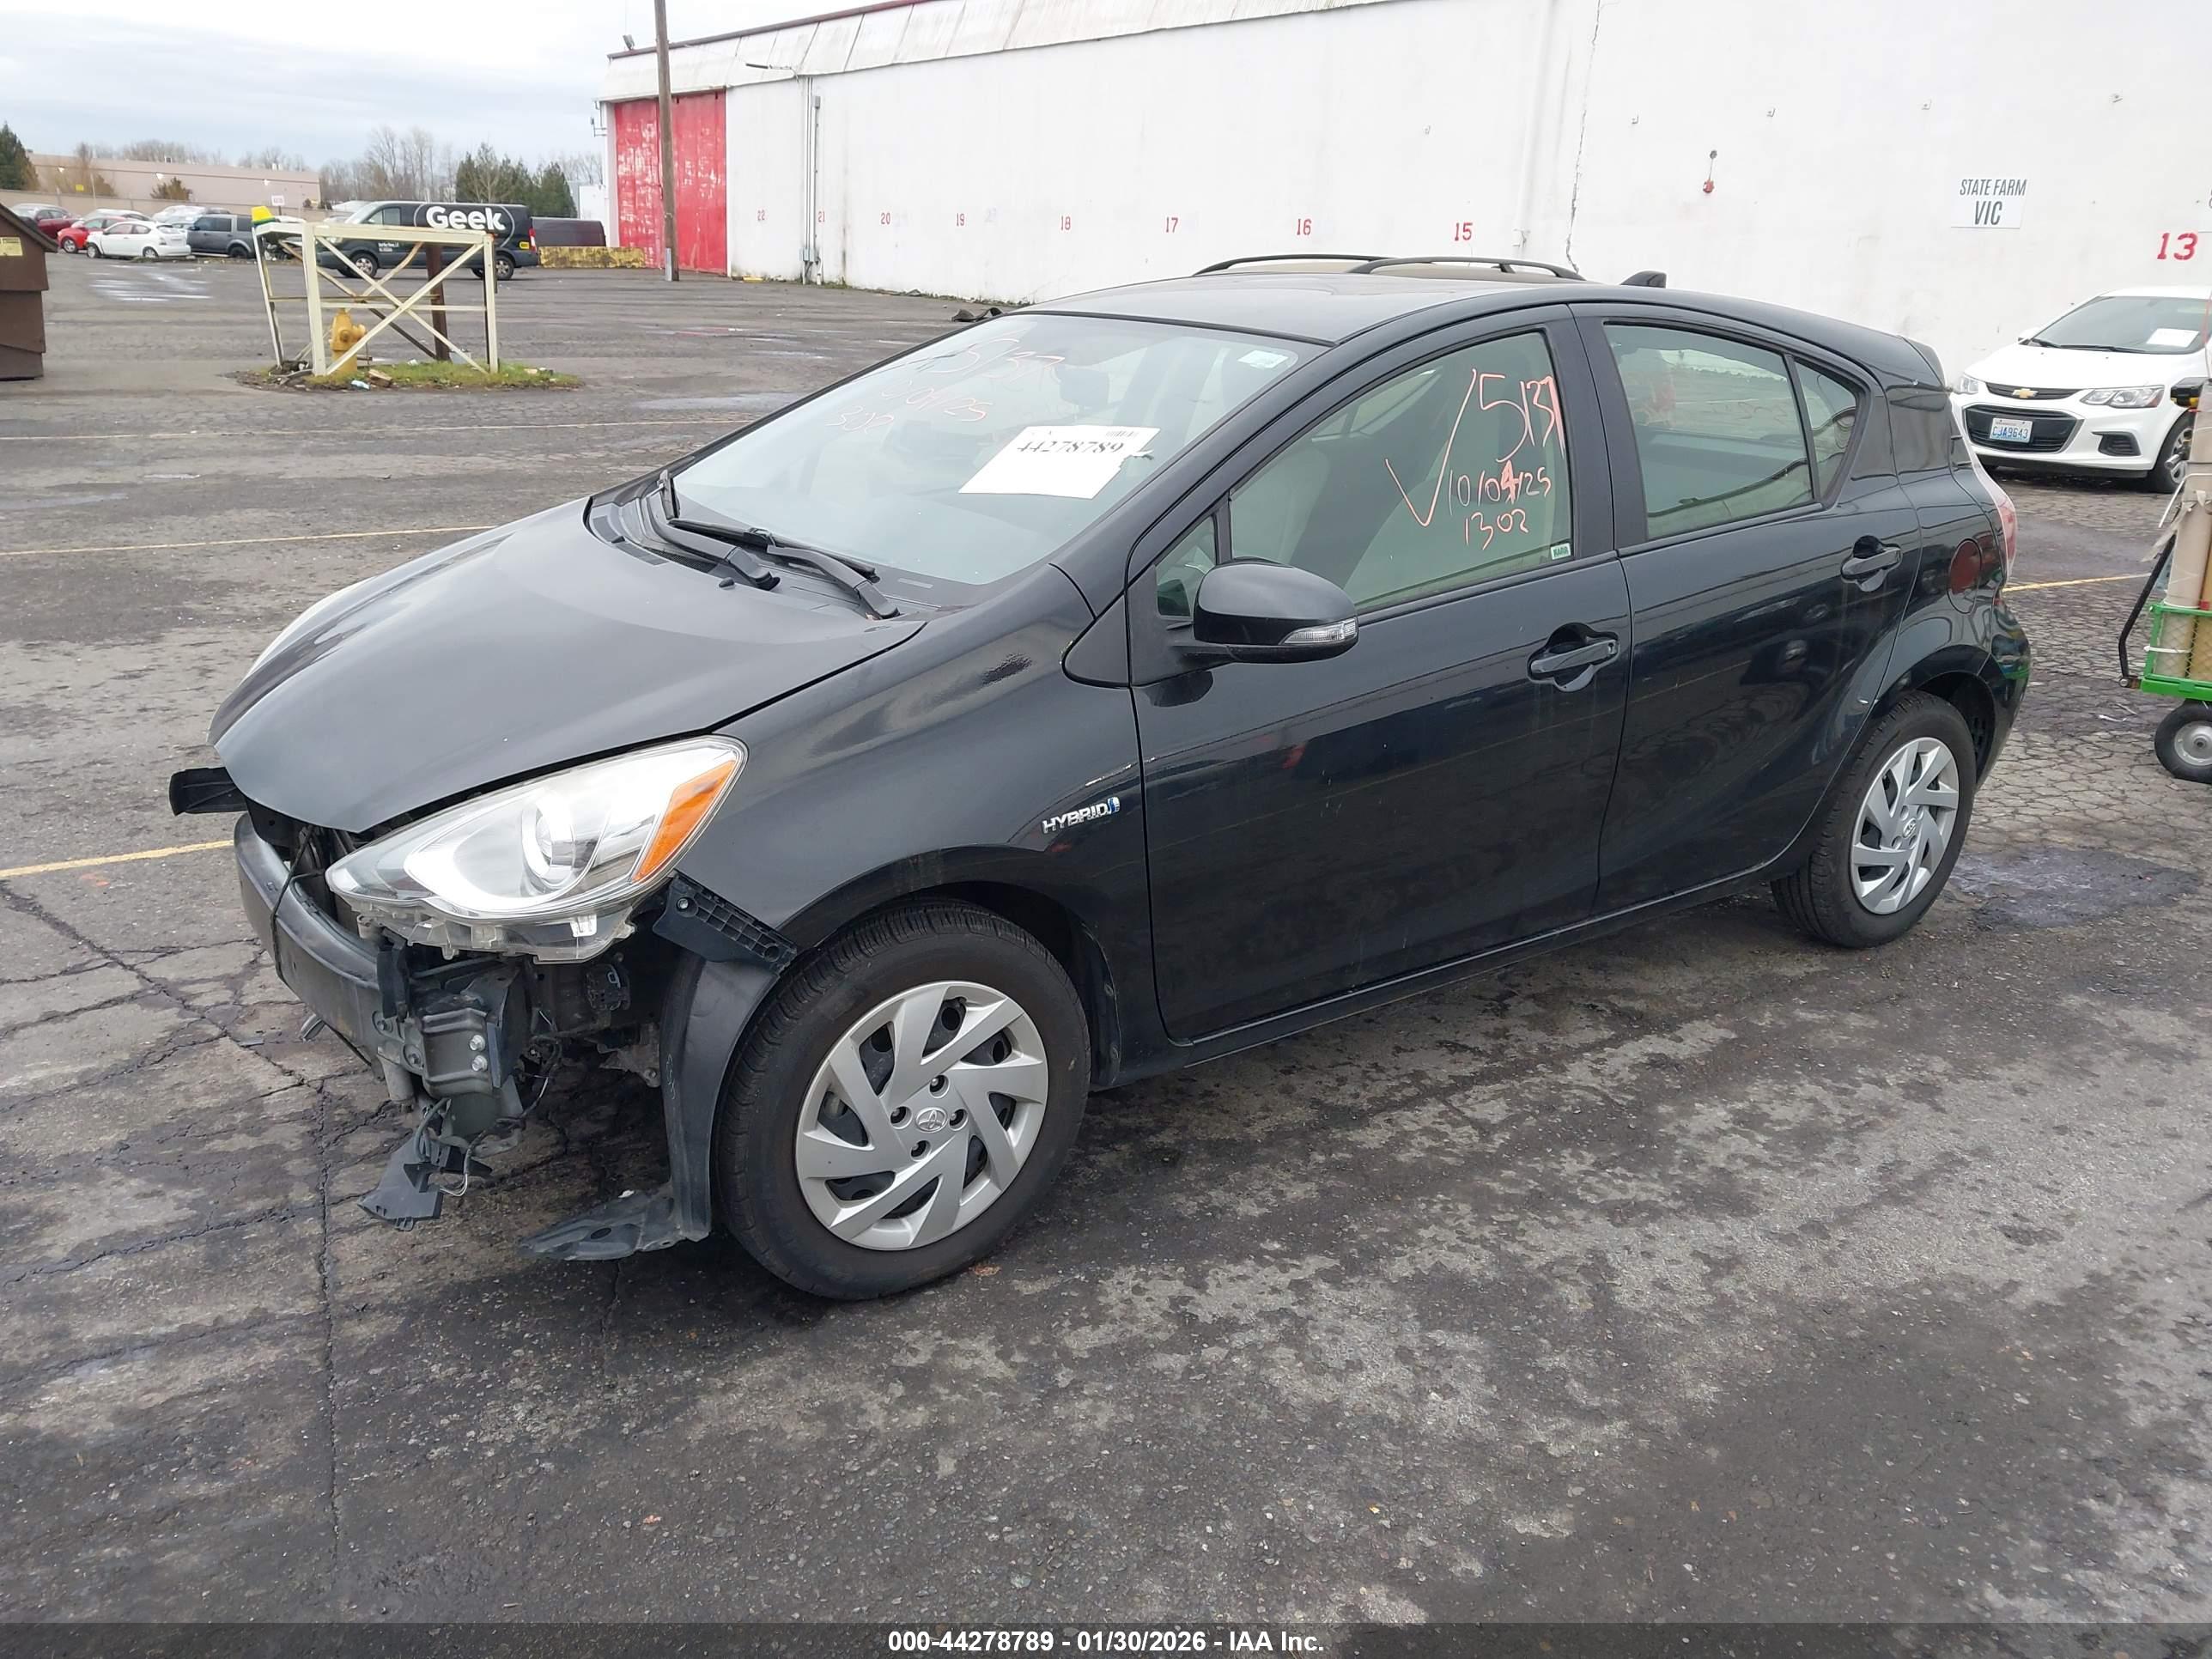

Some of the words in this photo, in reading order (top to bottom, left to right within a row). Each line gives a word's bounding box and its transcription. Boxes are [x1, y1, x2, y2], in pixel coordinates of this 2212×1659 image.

[1960, 178, 1992, 196] STATE
[1993, 178, 2027, 196] FARM
[426, 205, 506, 230] Geek
[757, 209, 766, 222] 22
[817, 210, 825, 222] 21
[880, 212, 891, 225] 20
[956, 212, 965, 227] 19
[1974, 200, 2002, 225] VIC
[1060, 216, 1072, 231] 18
[1165, 216, 1179, 234] 17
[1296, 218, 1312, 235] 16
[1454, 222, 1474, 241] 15
[2156, 232, 2198, 261] 13
[1991, 426, 2028, 439] CJA9643
[1017, 441, 1124, 453] 44278789
[1463, 508, 1529, 550] 1302
[1042, 802, 1109, 835] HYBRID
